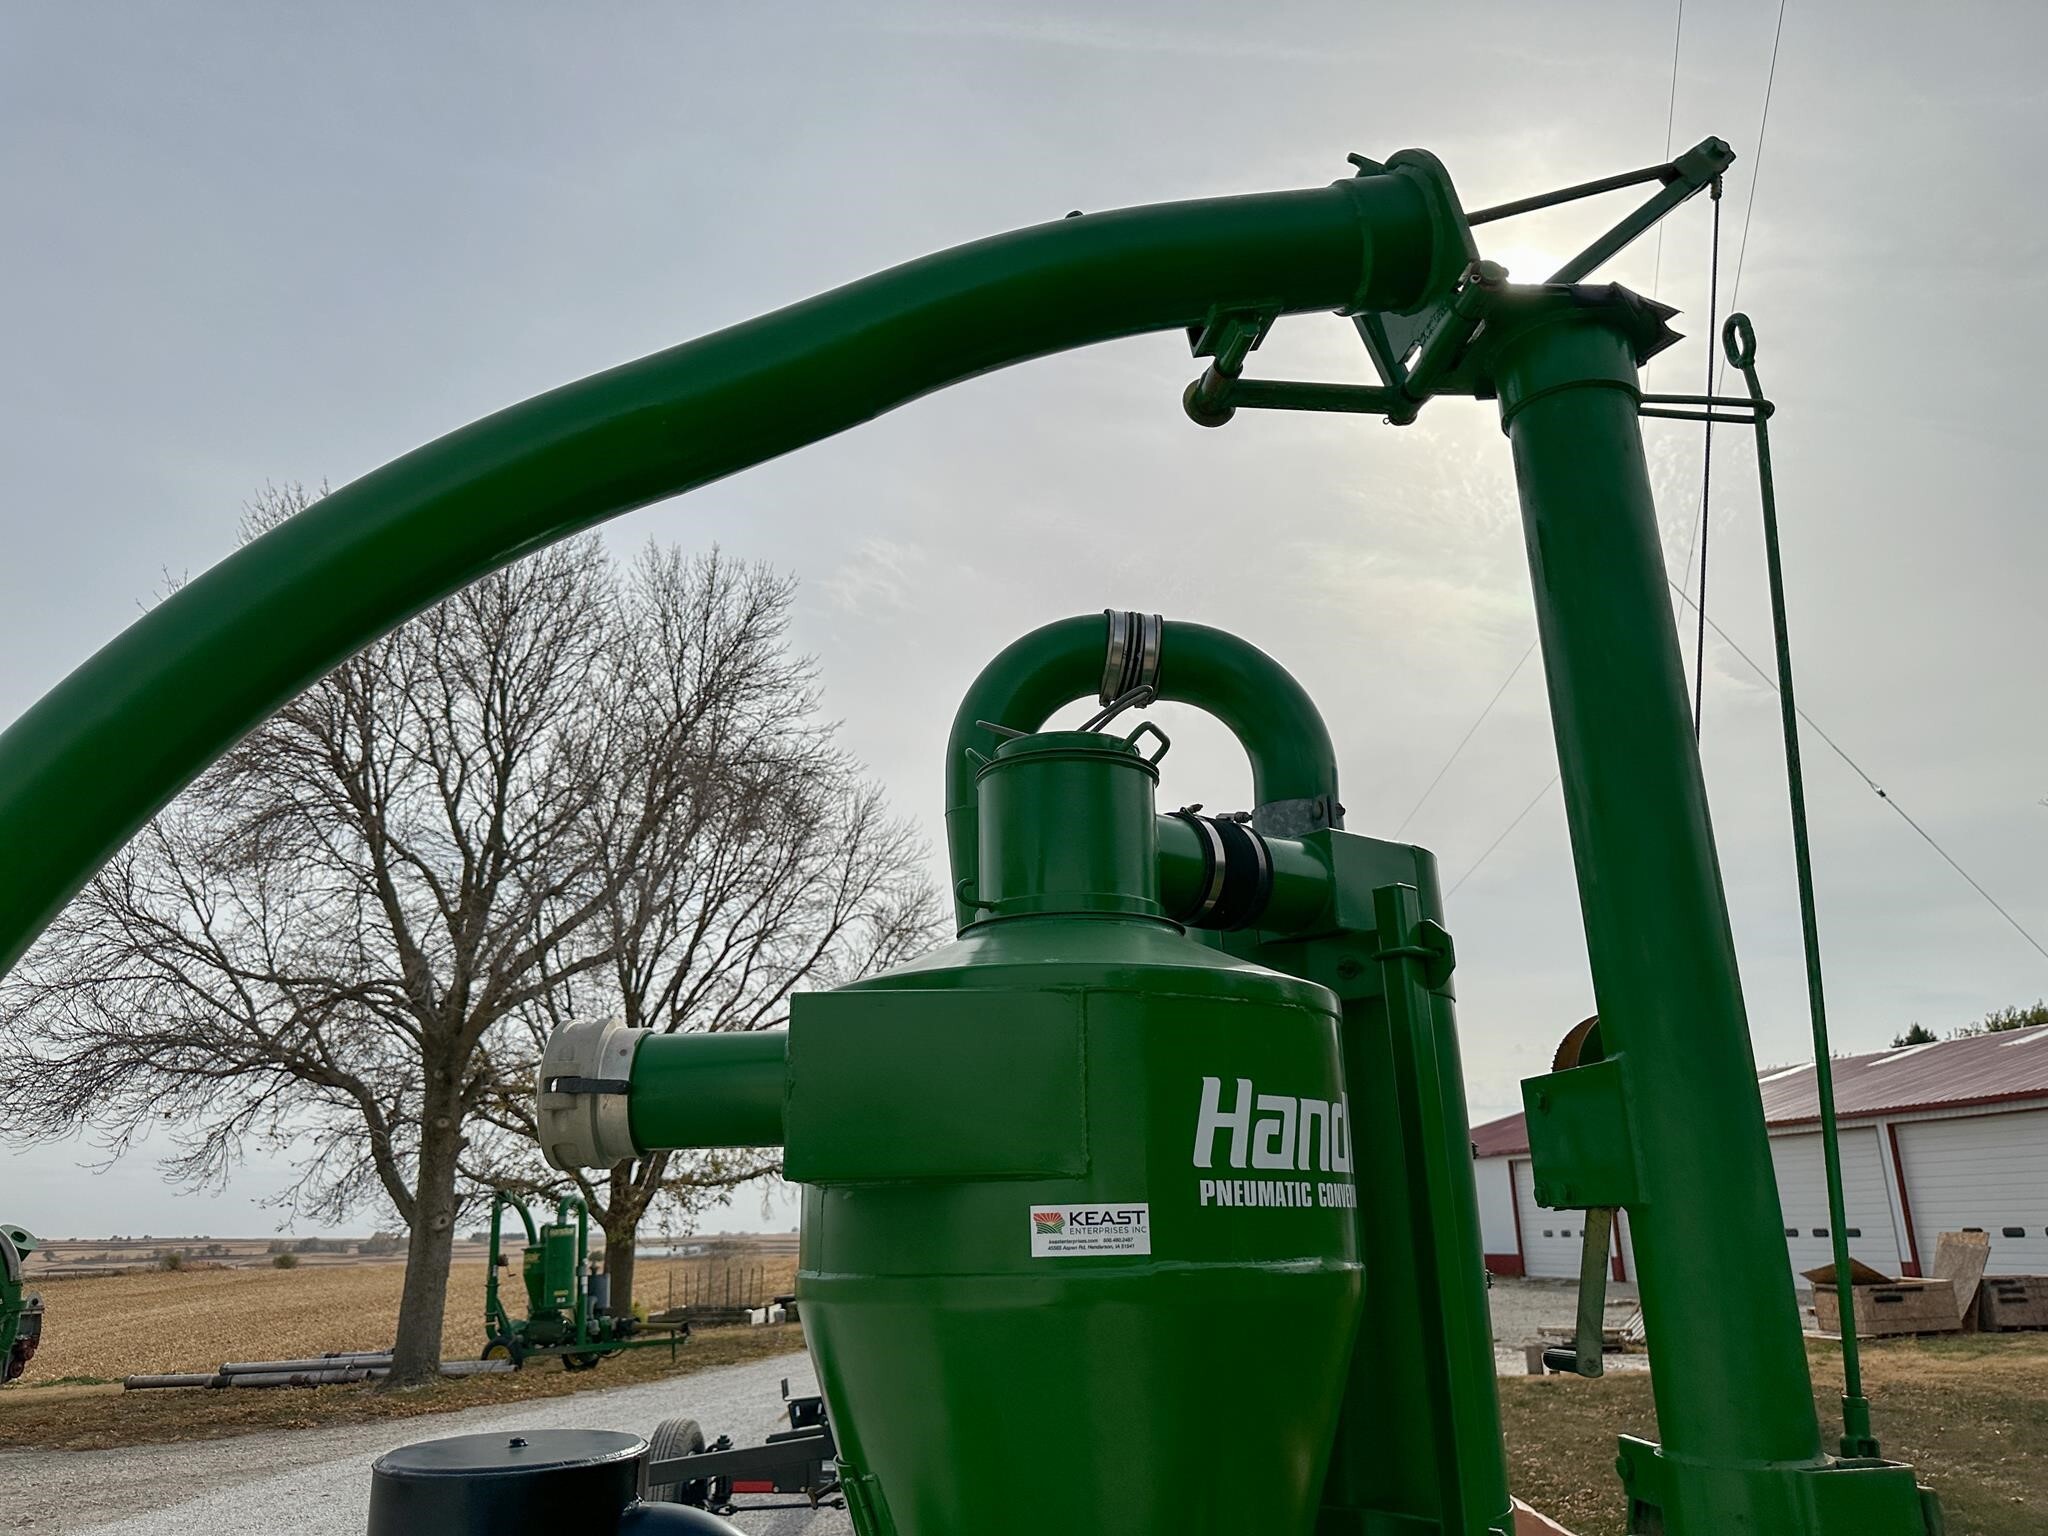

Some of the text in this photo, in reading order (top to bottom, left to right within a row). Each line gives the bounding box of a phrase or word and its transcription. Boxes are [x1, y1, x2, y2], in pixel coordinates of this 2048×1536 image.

[1193, 1077, 1354, 1174] Hand
[1200, 1180, 1312, 1207] PNEUMATIC
[1069, 1210, 1146, 1226] KEAST
[1069, 1227, 1129, 1235] ENTERPRISES
